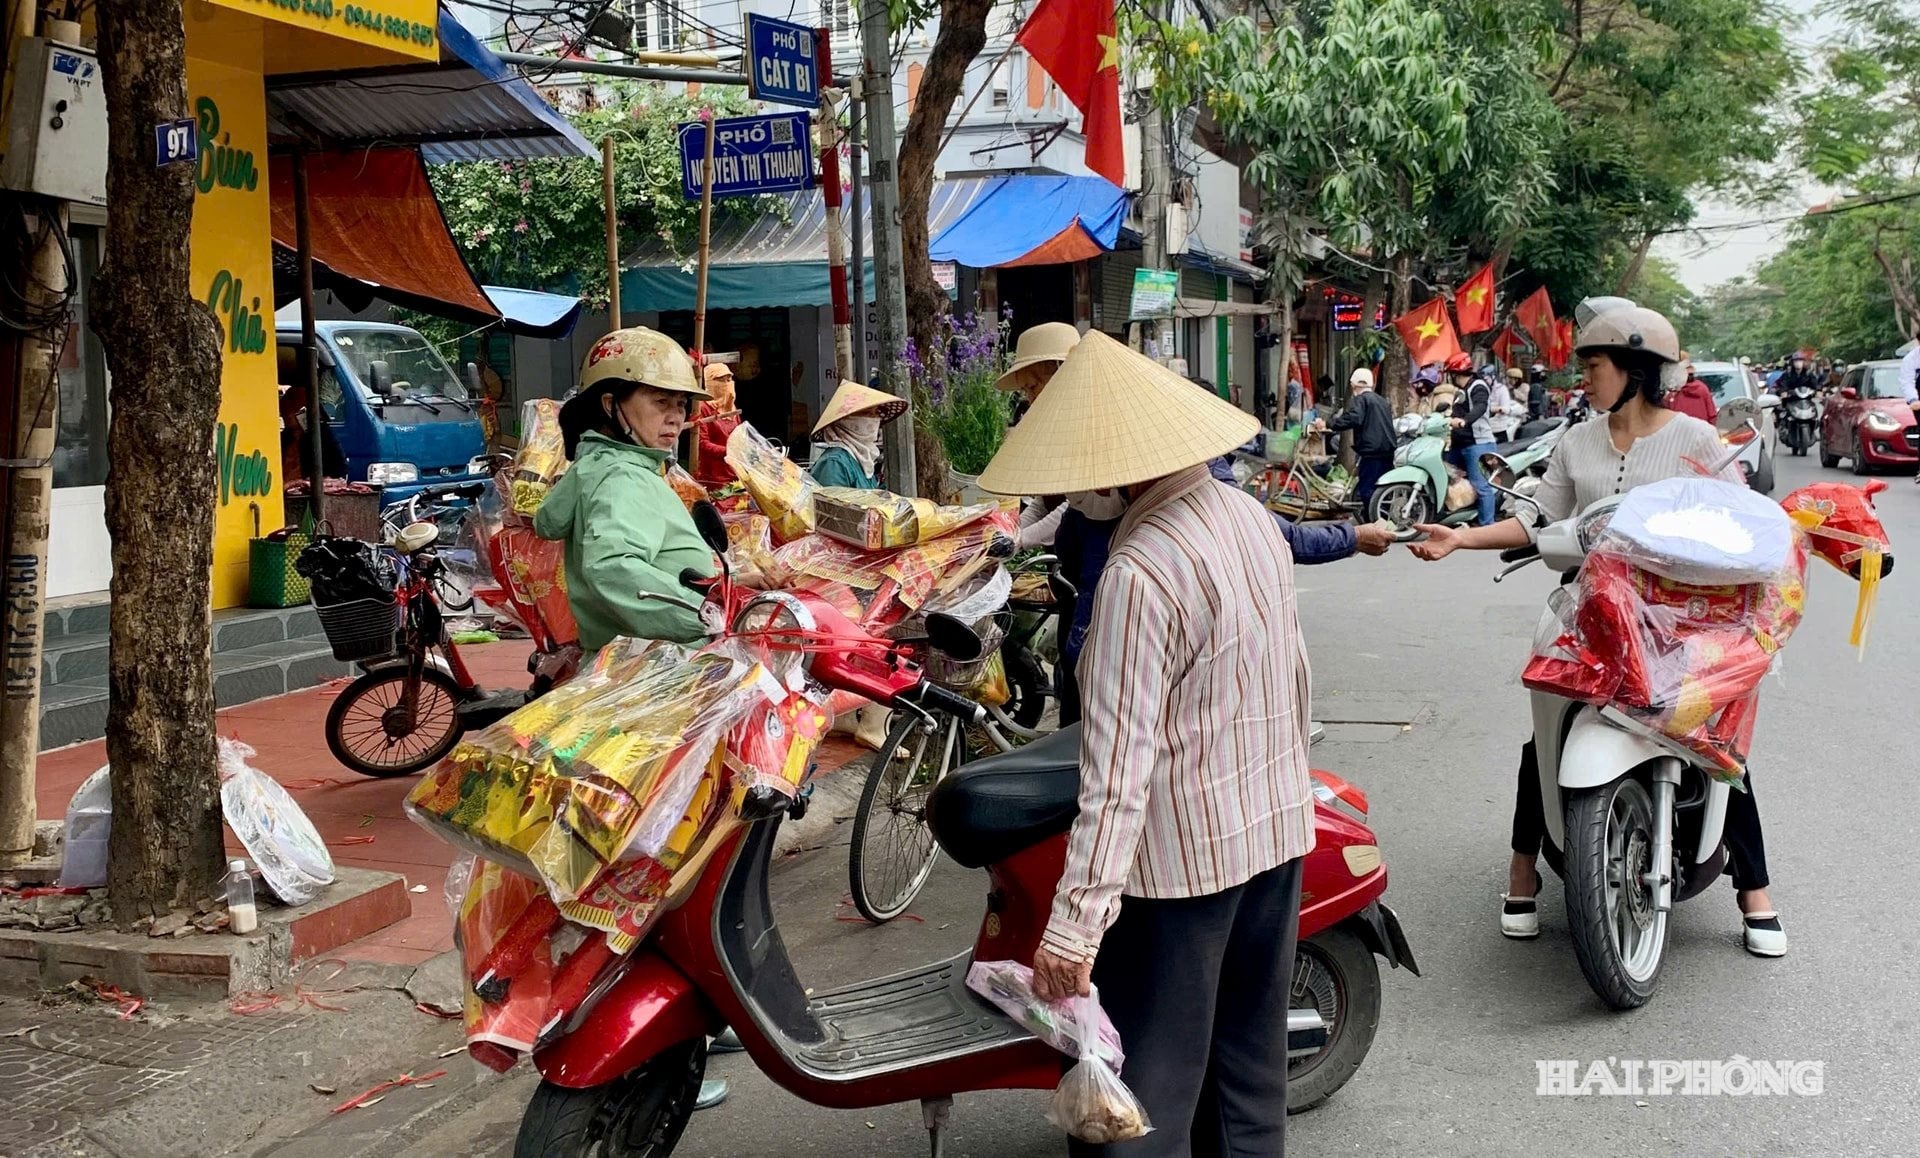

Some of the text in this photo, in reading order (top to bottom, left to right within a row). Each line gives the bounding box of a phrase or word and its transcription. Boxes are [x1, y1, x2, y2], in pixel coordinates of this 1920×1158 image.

[772, 28, 797, 50] PHỐ
[66, 76, 91, 88] VNPT
[761, 51, 811, 93] CÁT BI
[167, 126, 189, 158] 97
[720, 120, 766, 145] PHỐ
[741, 153, 762, 186] THỊ
[763, 145, 804, 183] THUẬN
